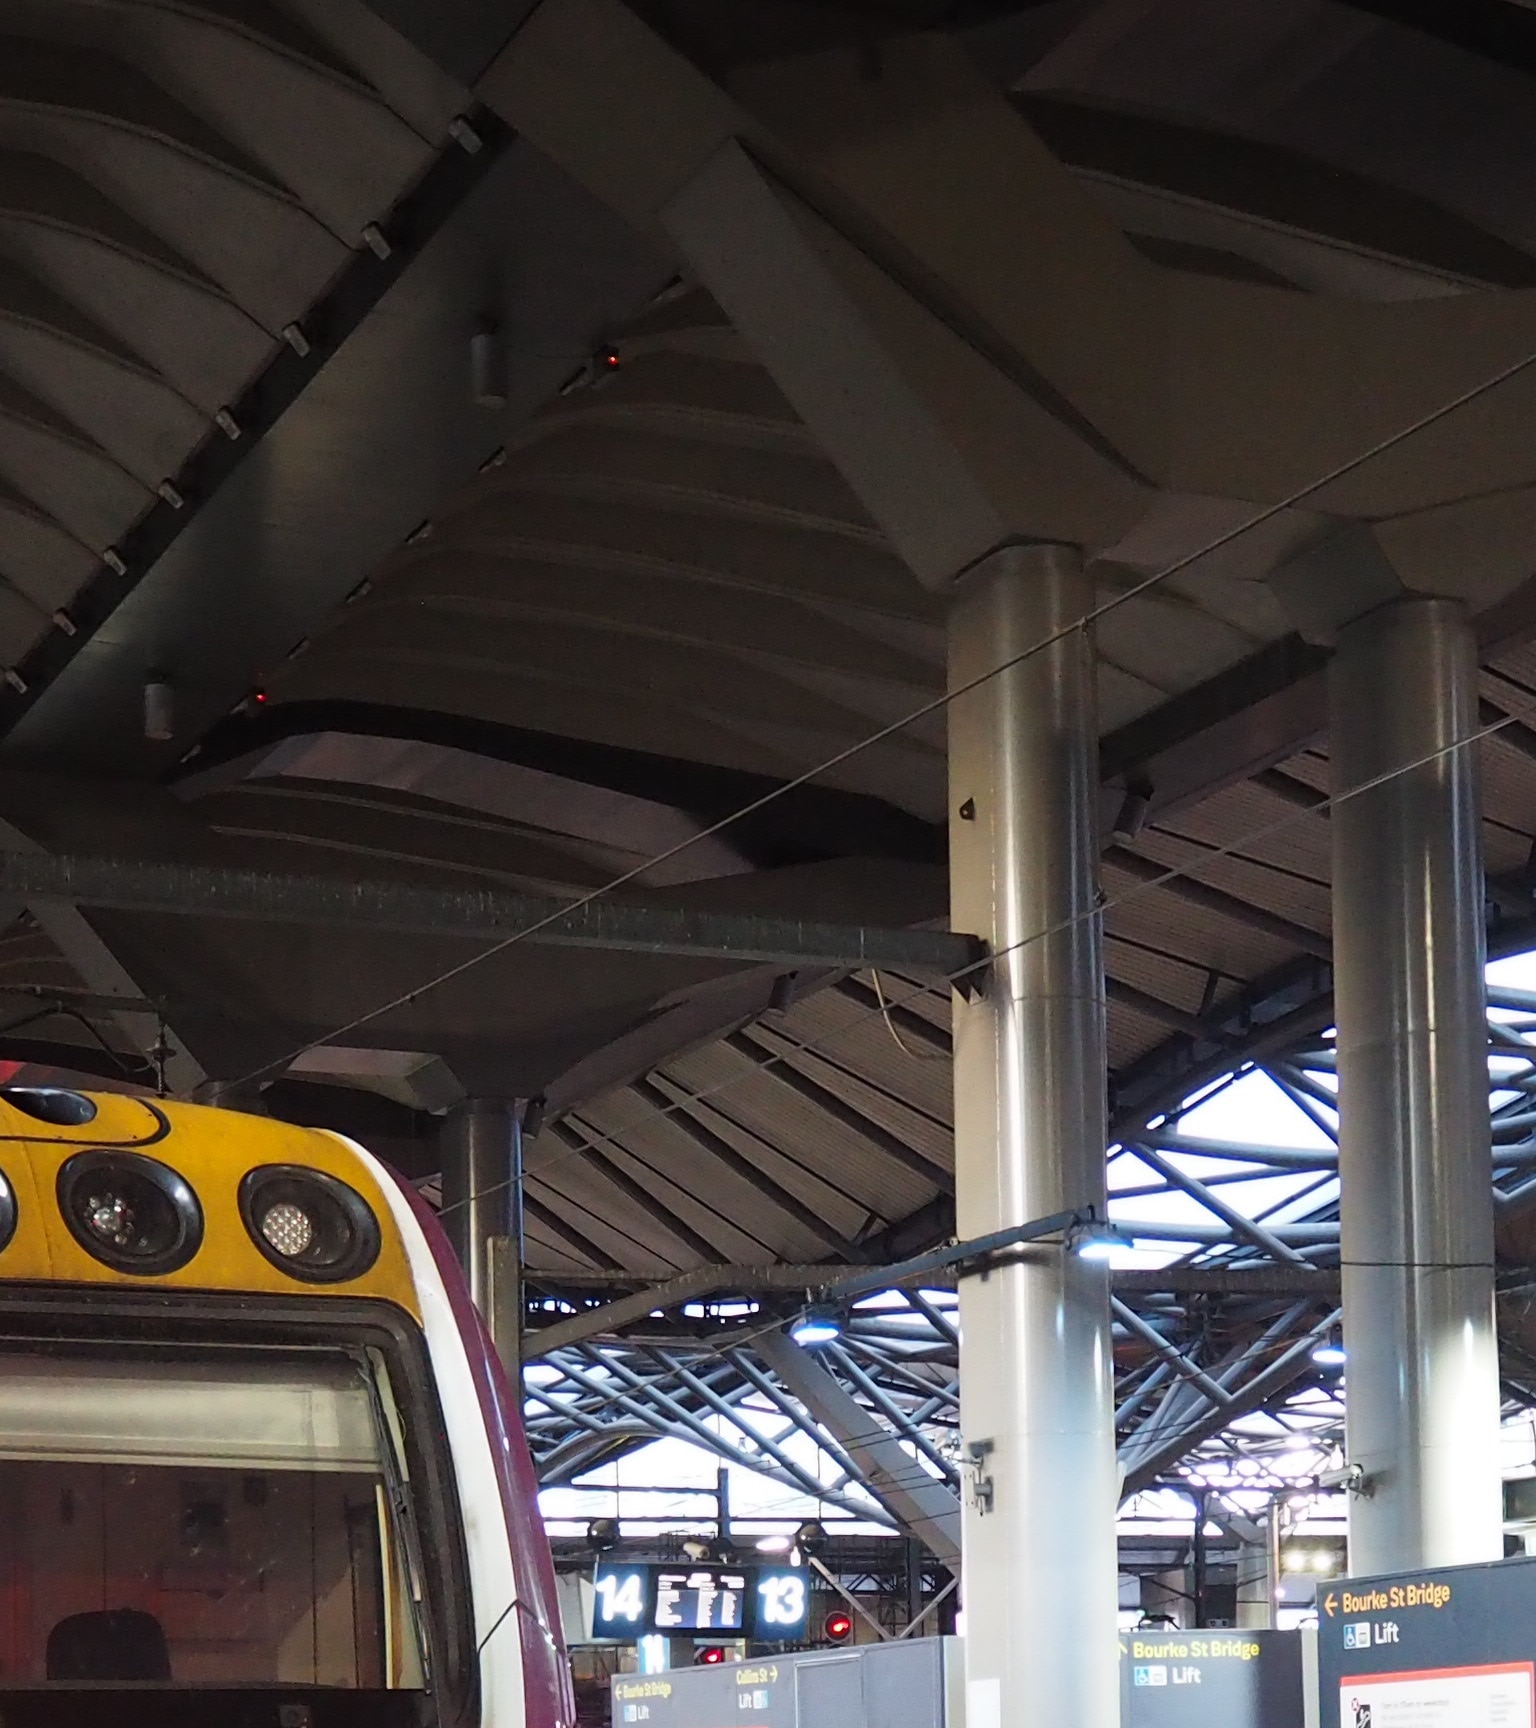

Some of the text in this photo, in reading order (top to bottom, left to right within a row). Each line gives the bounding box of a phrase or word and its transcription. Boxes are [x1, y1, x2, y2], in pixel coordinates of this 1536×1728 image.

[596, 1574, 643, 1622] 14
[758, 1575, 804, 1624] 13
[1342, 1583, 1451, 1613] Bourke St Bridge
[1374, 1621, 1400, 1644] Lift
[1133, 1640, 1260, 1660] Bourke St Bridge
[1172, 1666, 1202, 1684] Lift
[738, 1693, 753, 1709] Lift
[637, 1704, 650, 1720] Lift
